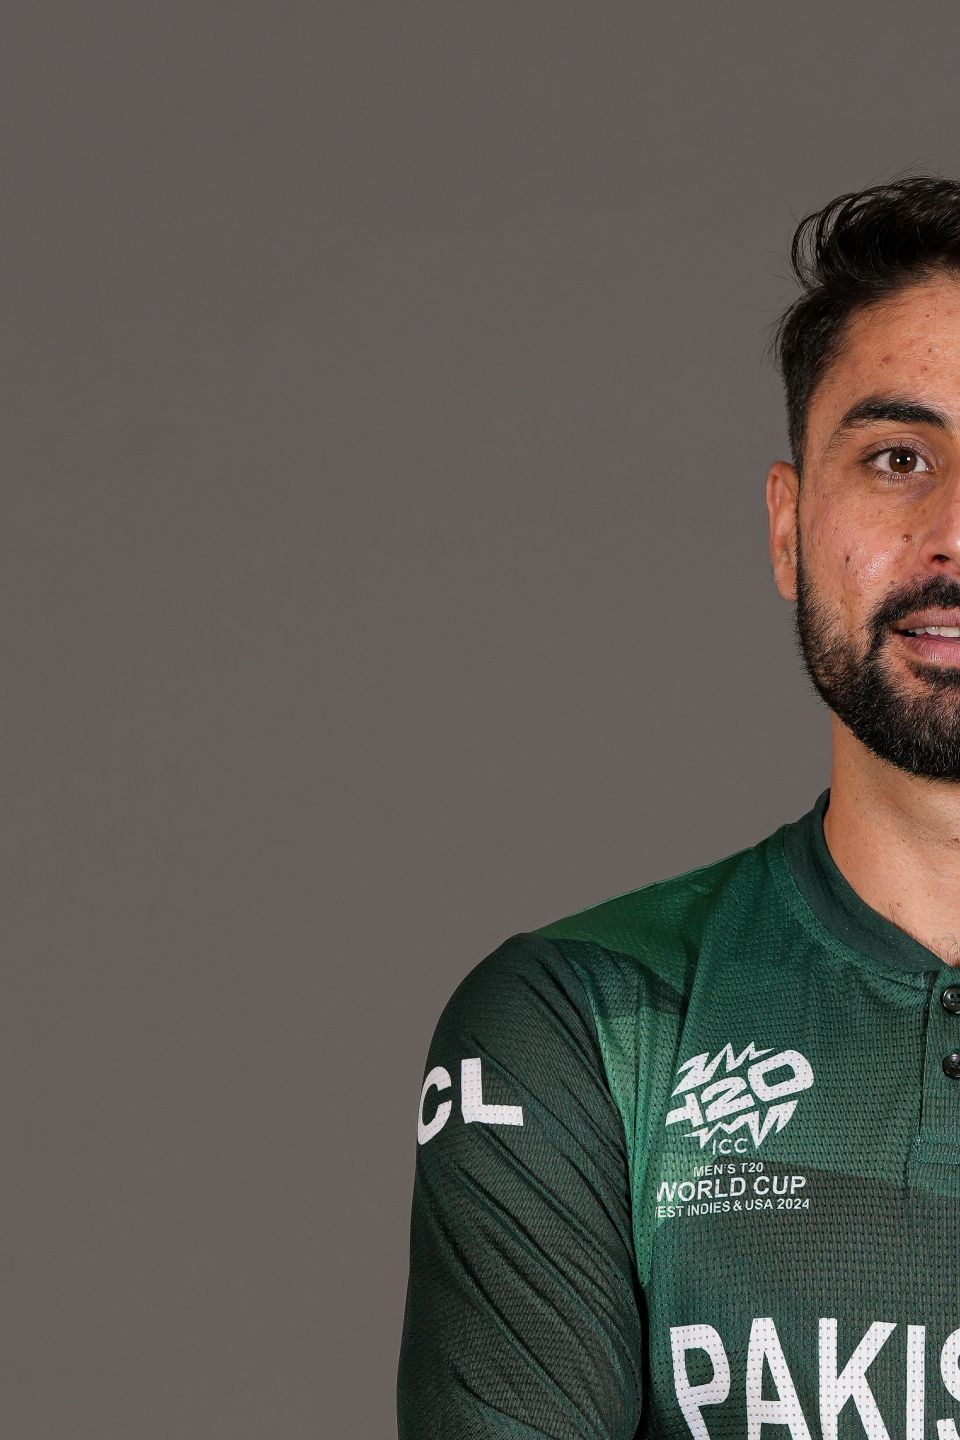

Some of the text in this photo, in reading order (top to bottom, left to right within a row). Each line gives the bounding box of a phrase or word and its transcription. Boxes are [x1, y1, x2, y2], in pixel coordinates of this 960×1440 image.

[712, 1137, 749, 1155] ICC
[693, 1162, 764, 1178] MEN'S T20
[656, 1175, 806, 1202] WORLD CUP
[655, 1198, 810, 1218] EST INDIES & USA 2024
